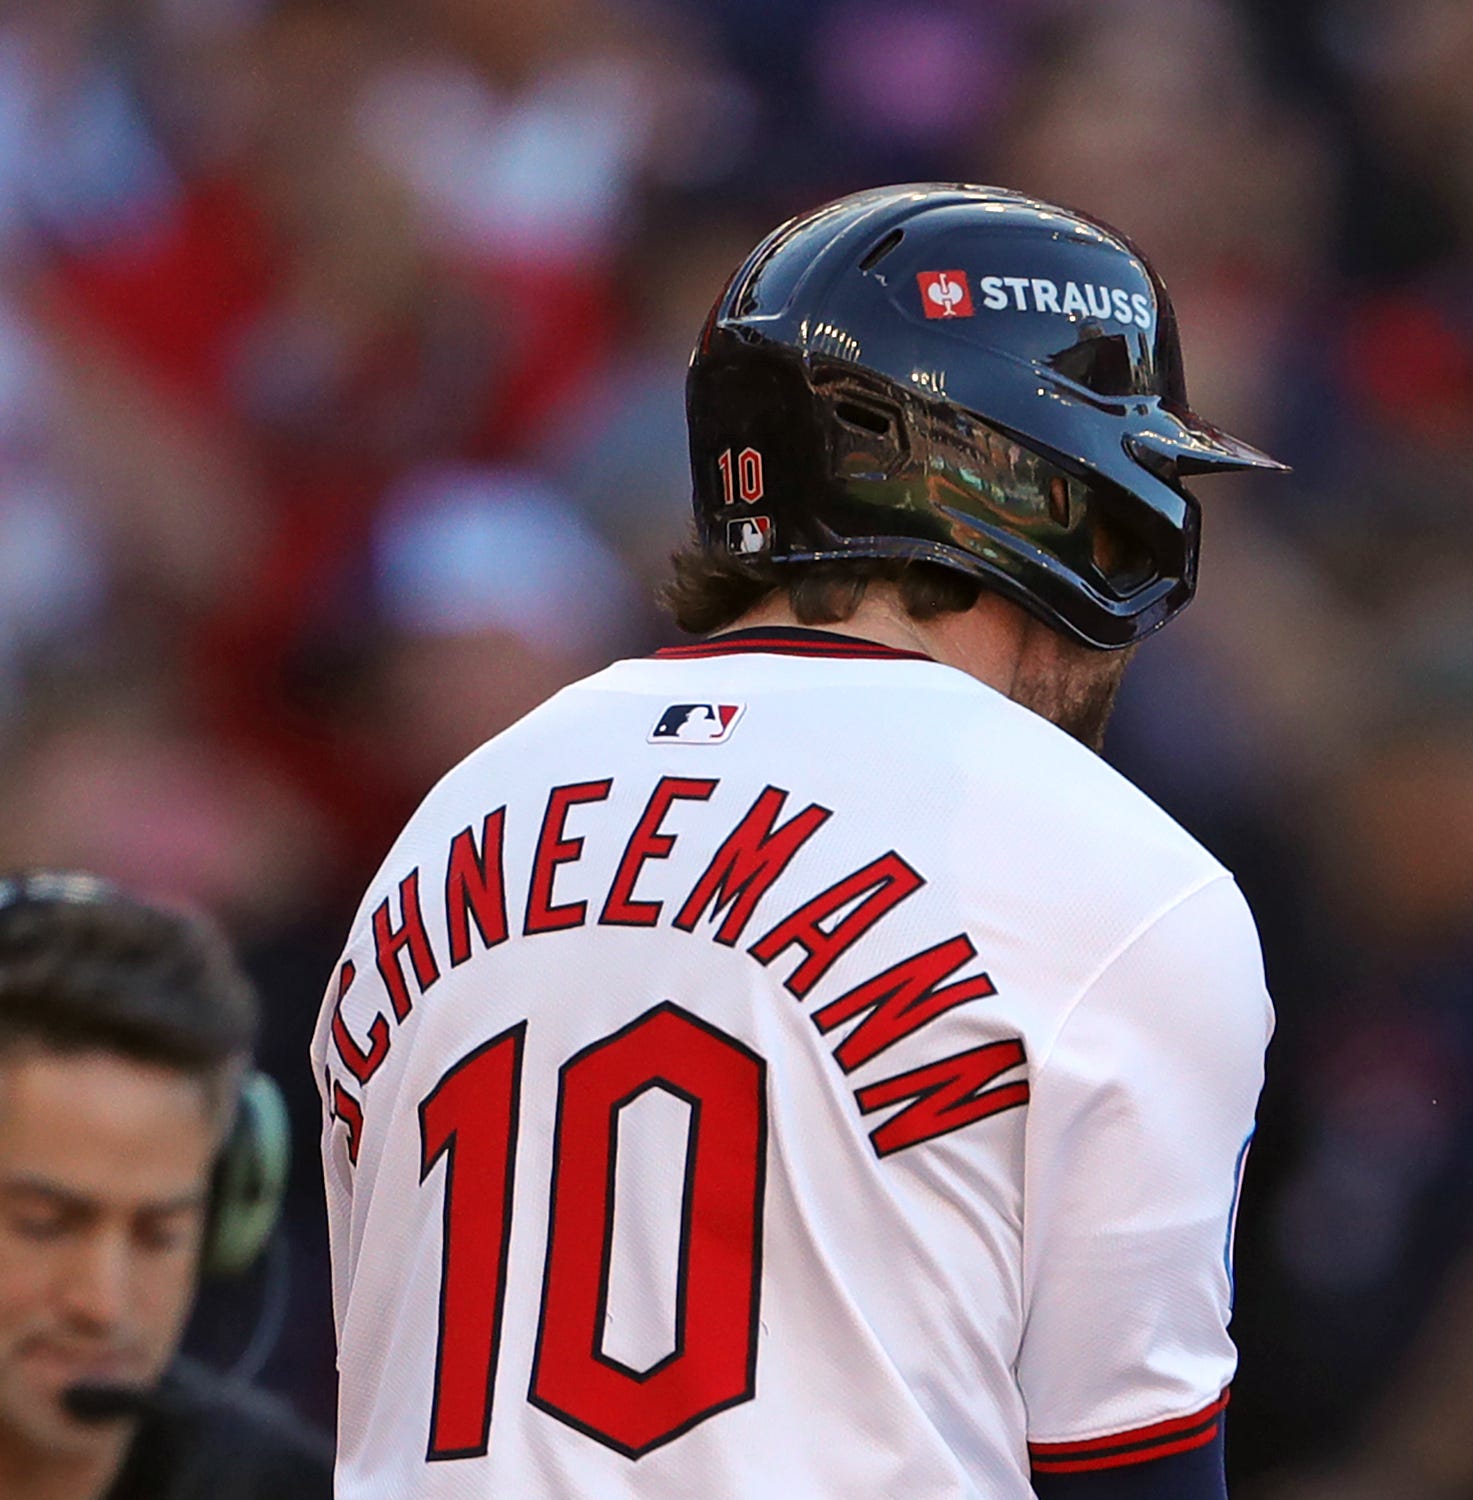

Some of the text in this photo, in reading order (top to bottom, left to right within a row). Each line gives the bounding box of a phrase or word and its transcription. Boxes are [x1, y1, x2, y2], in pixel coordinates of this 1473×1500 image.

[980, 275, 1152, 329] STRAUSS
[718, 447, 764, 504] 10
[419, 1001, 766, 1463] 10
